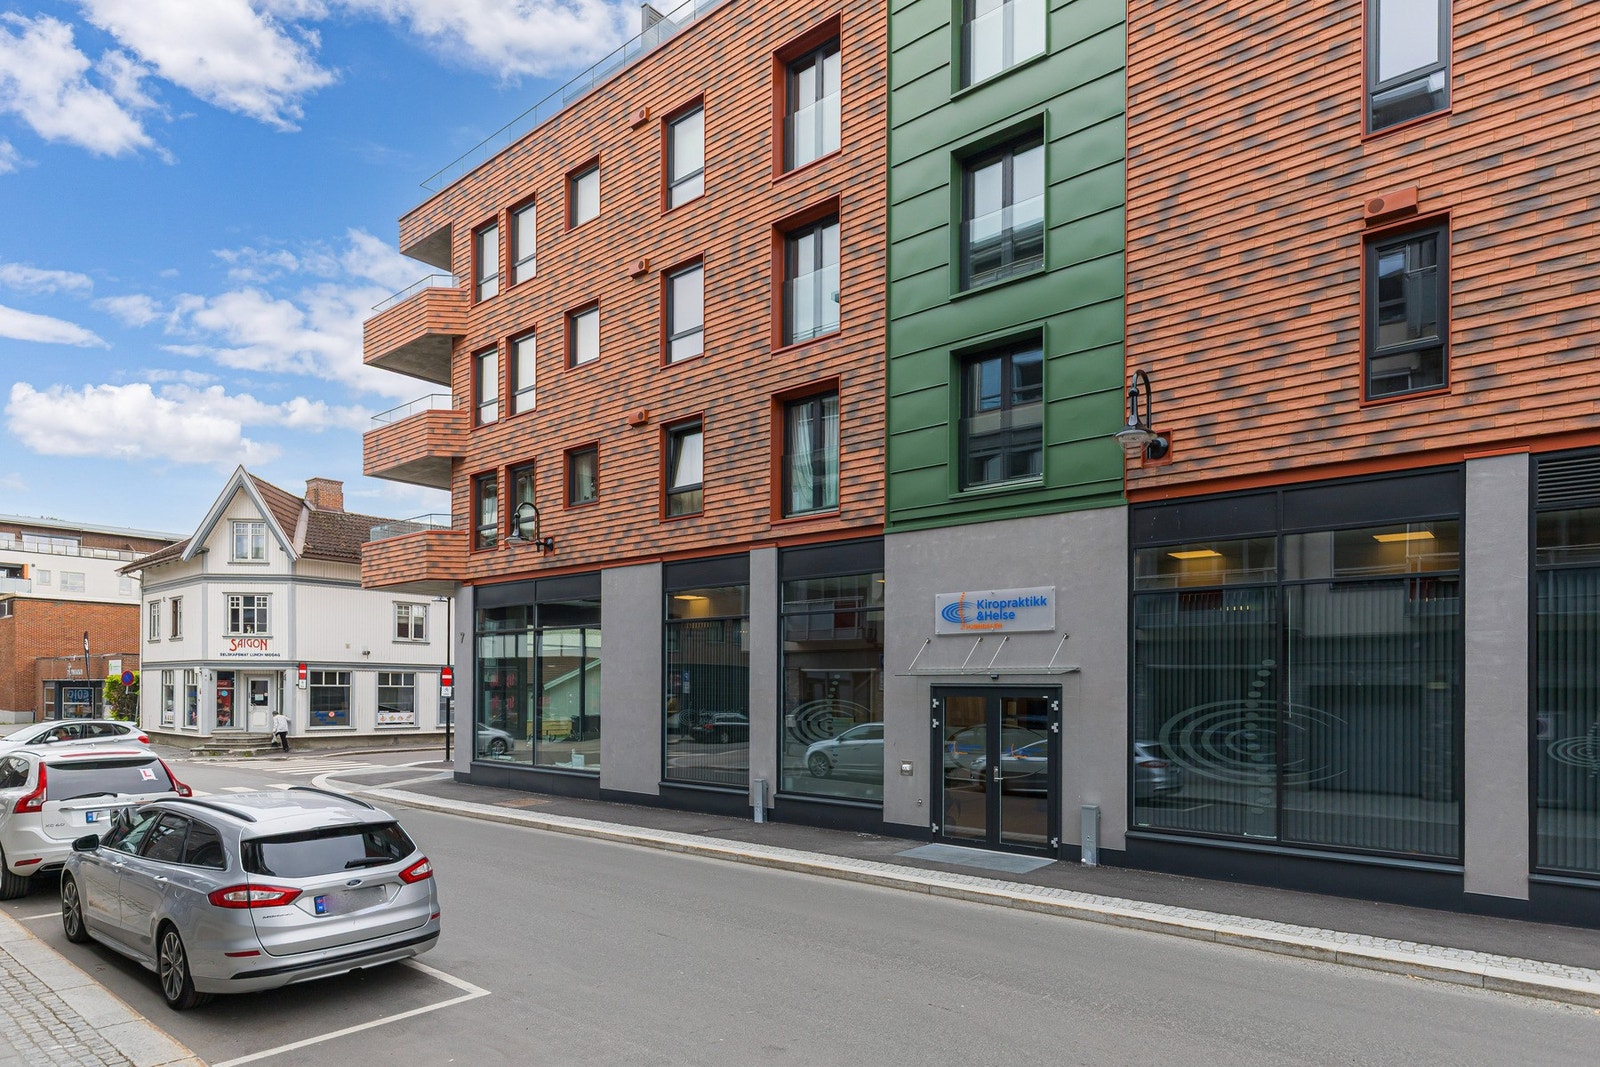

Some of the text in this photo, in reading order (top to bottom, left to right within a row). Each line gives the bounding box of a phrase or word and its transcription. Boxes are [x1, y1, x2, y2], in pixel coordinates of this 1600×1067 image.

[976, 596, 1048, 612] Kiropraktikk
[976, 609, 1015, 621] &Helse
[460, 632, 465, 643] 7
[229, 638, 268, 652] SAIGON
